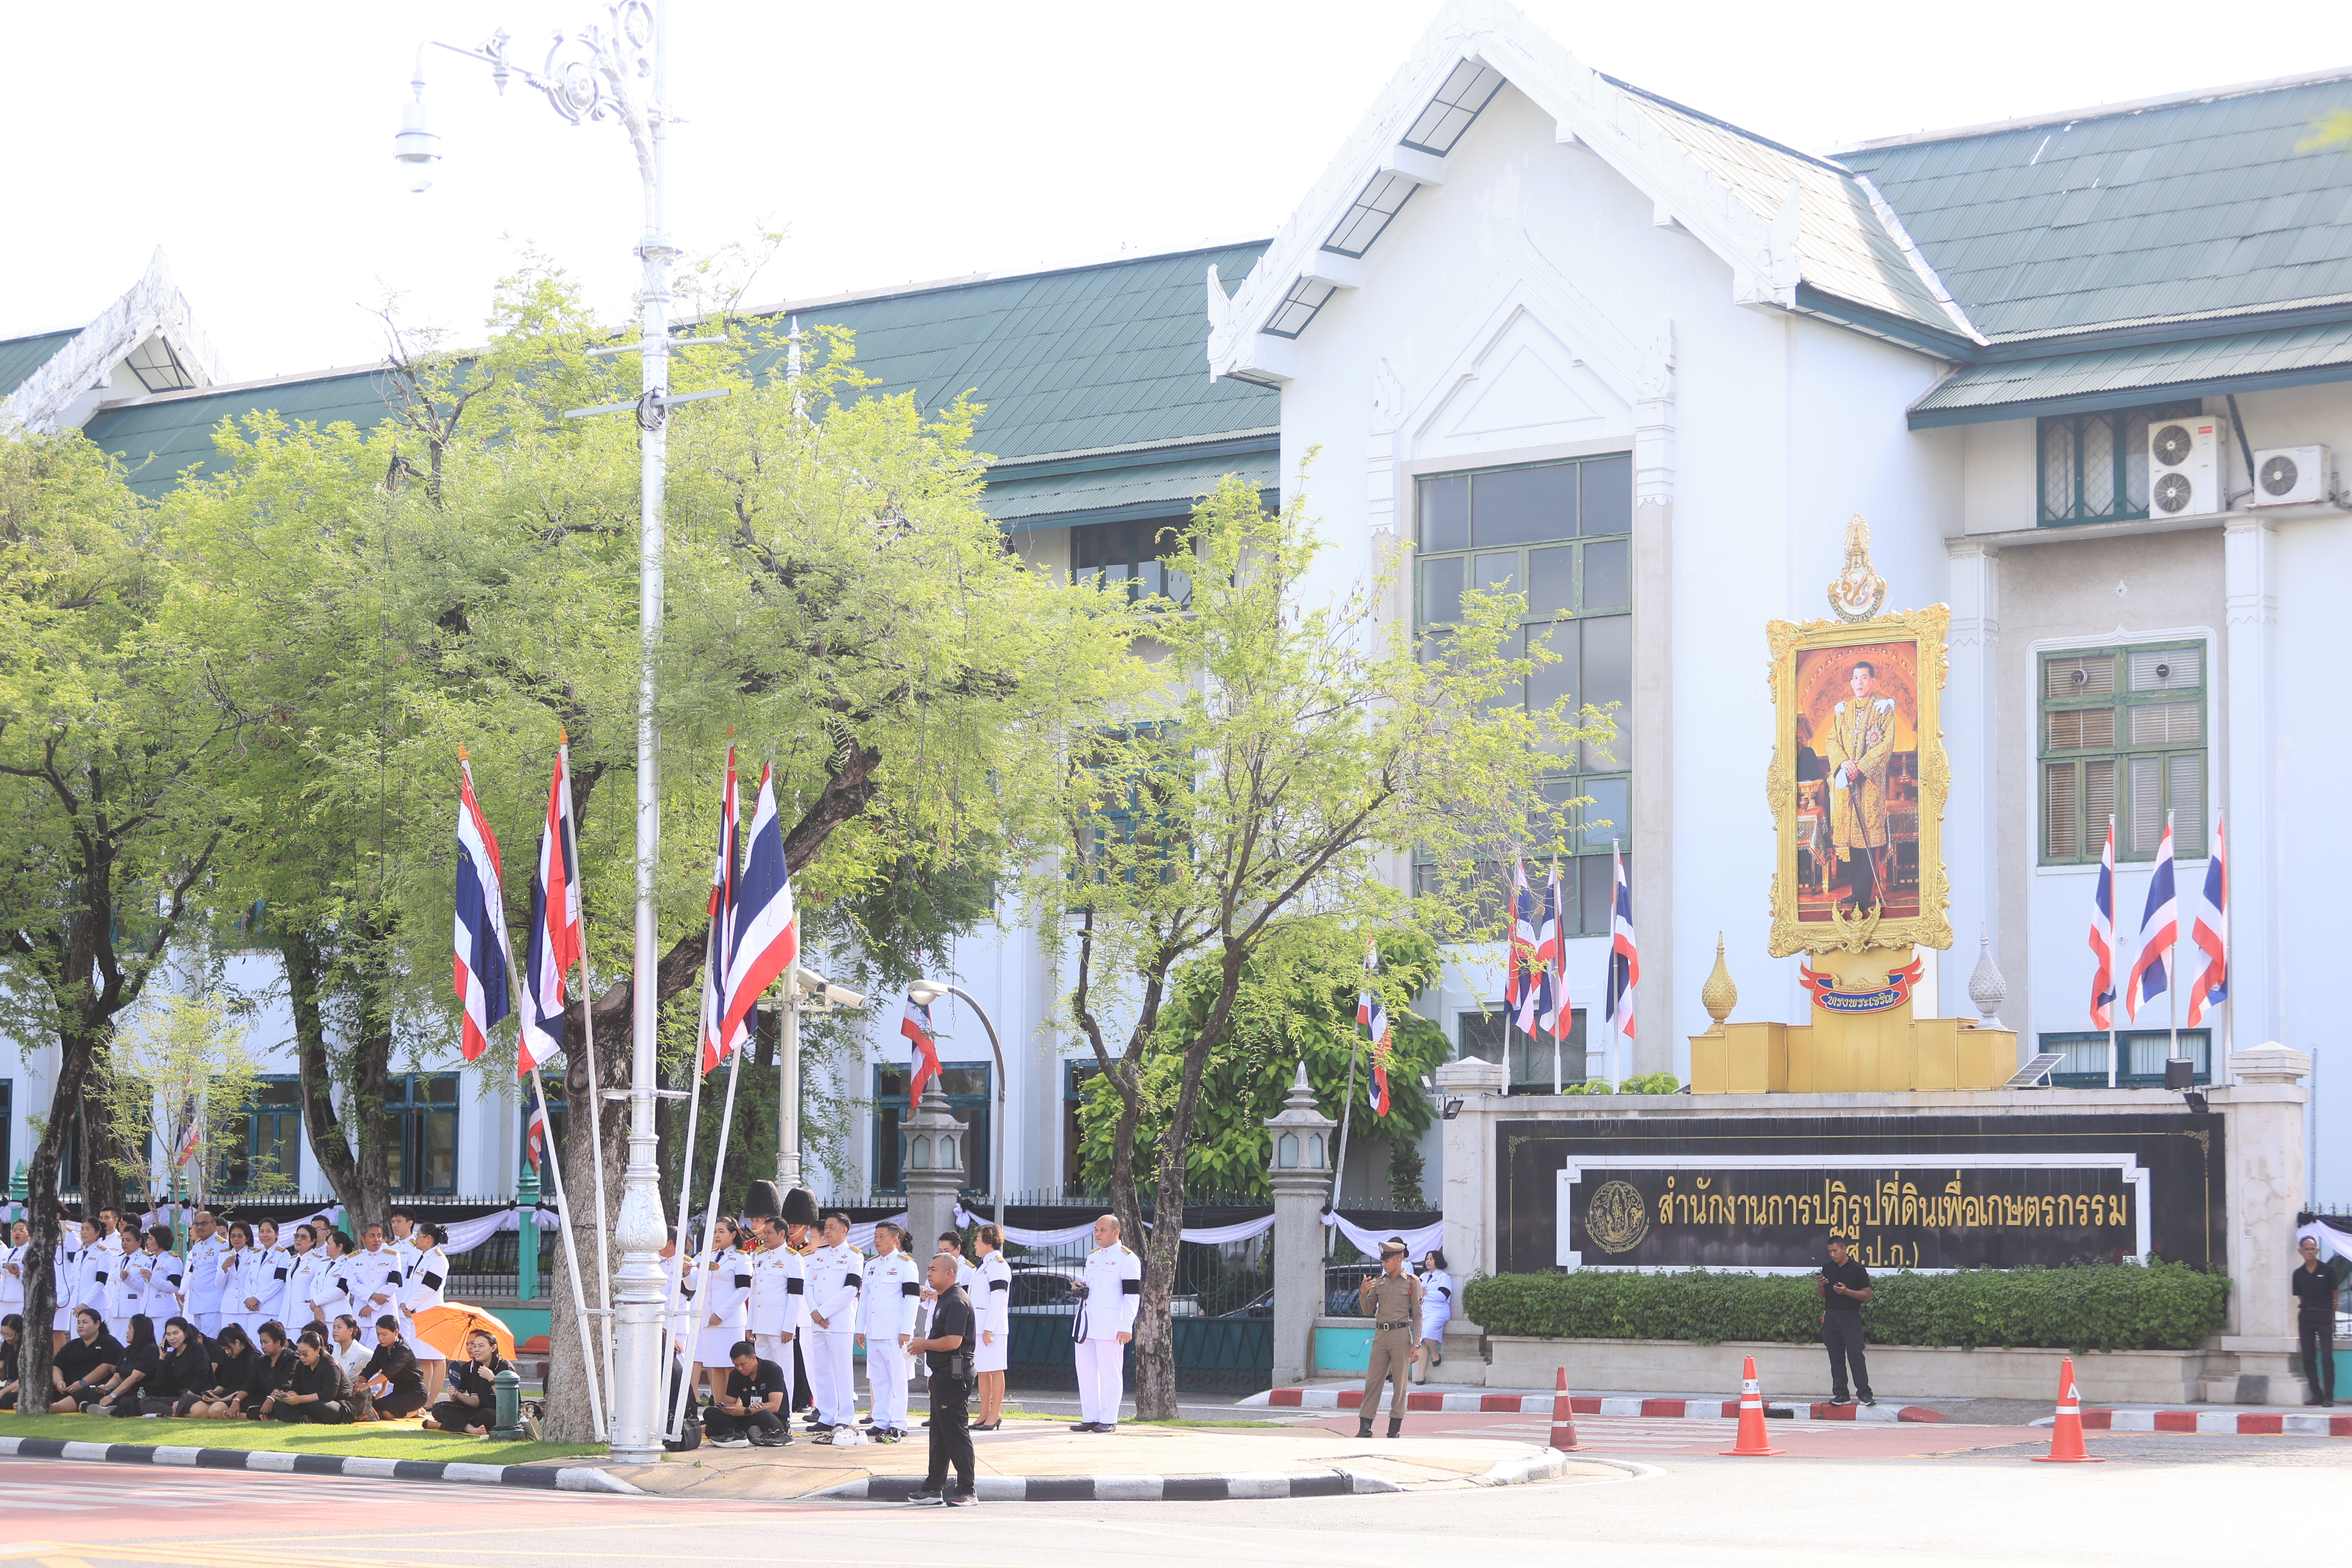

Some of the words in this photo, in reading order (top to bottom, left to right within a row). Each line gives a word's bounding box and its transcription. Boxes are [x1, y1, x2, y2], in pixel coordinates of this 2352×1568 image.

[1832, 599, 1880, 623] ทรงพระเจริญ
[1827, 992, 1894, 1008] ทรงพระเจริญ
[1658, 1170, 2126, 1240] สำนักงานการปฏิรูปที่ดินเพื่อเกษตรกรรม
[1845, 1235, 1919, 1269] ส.ป.ก.)
